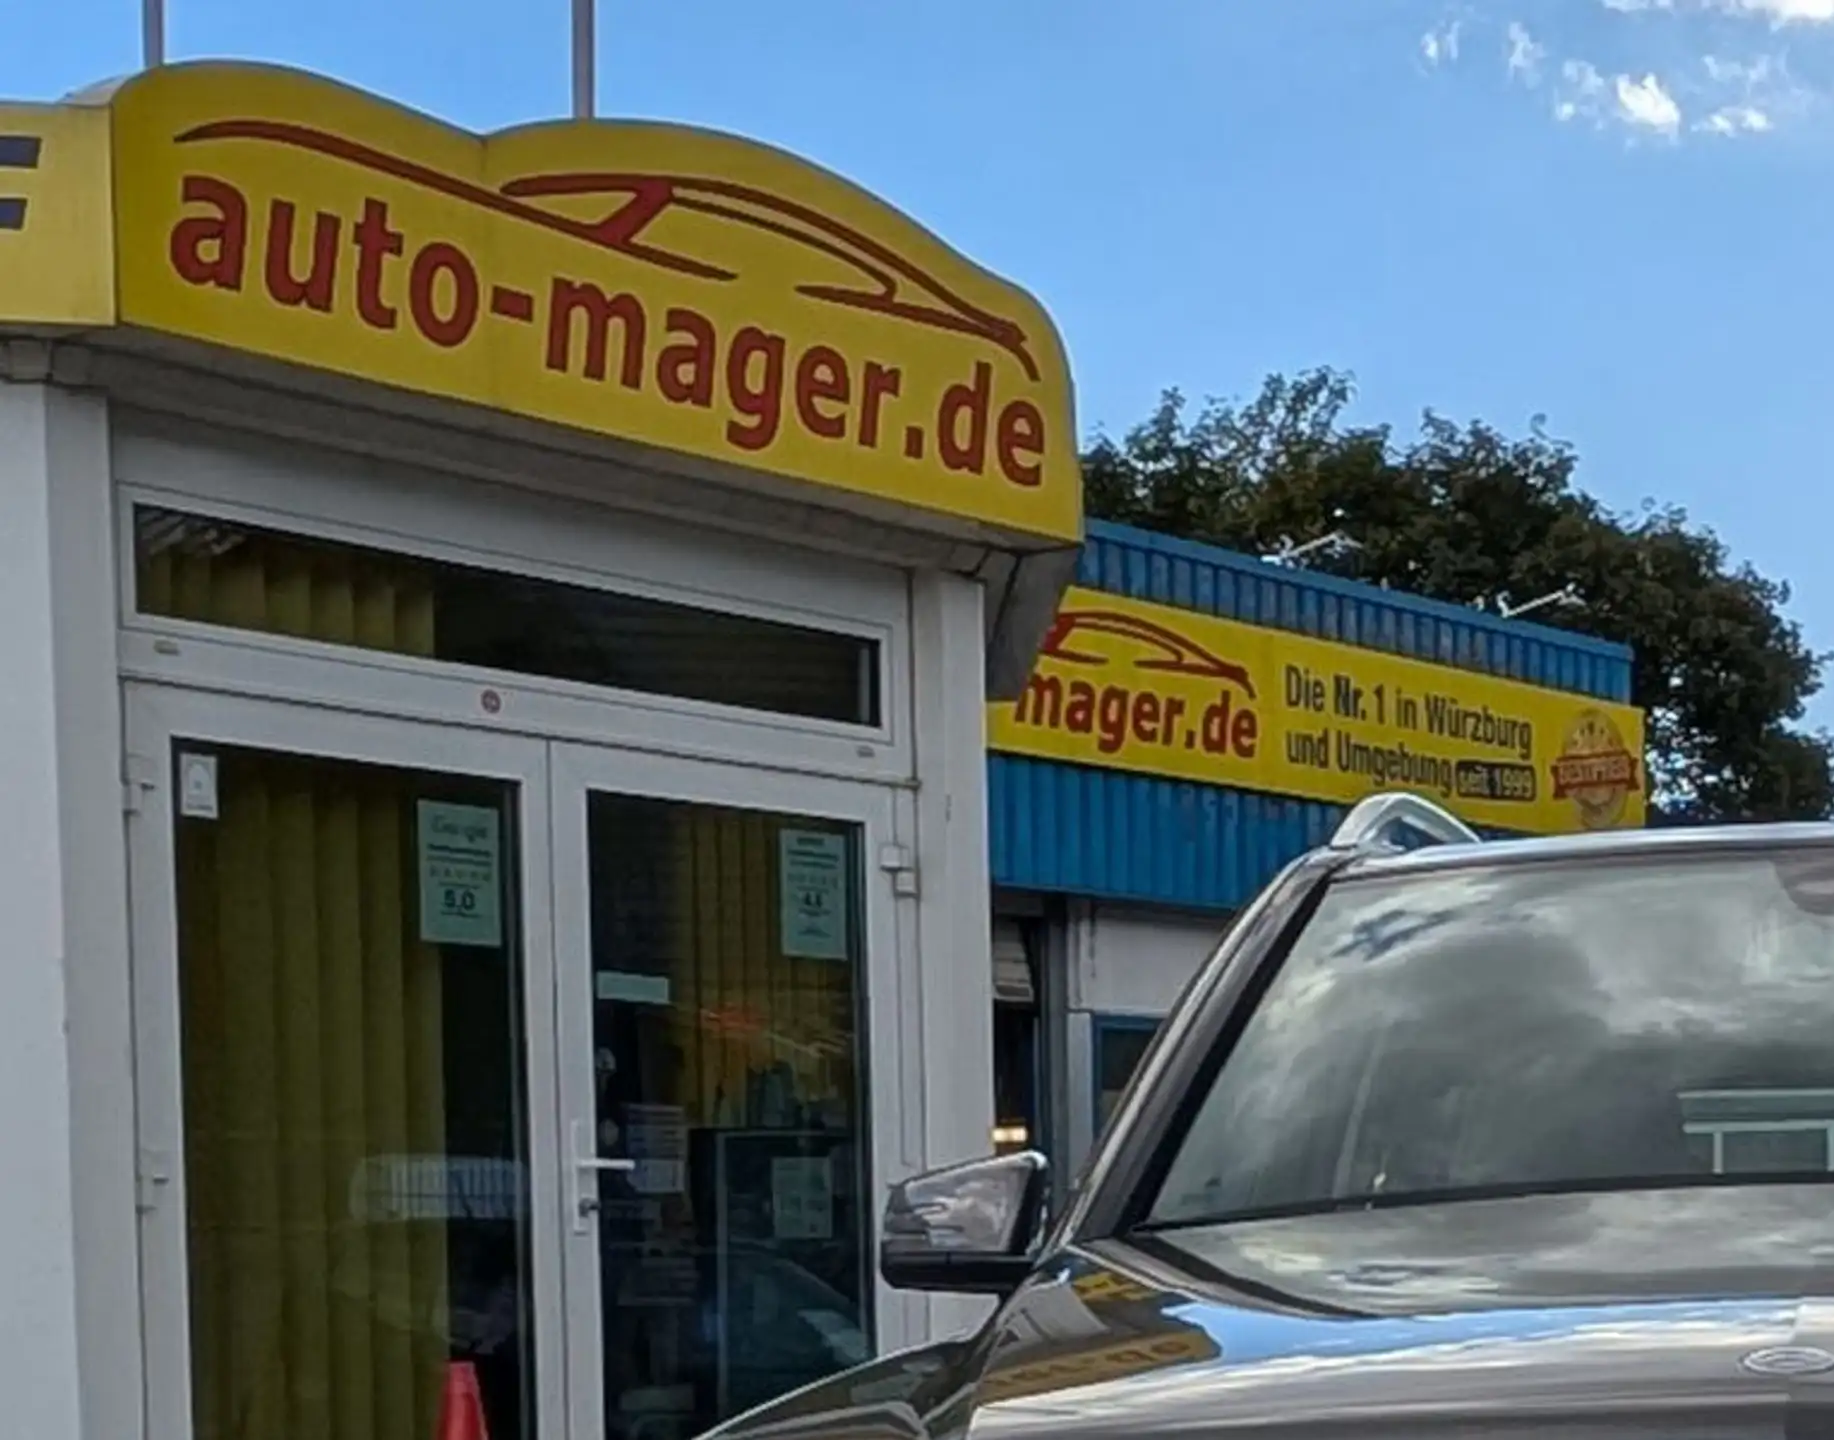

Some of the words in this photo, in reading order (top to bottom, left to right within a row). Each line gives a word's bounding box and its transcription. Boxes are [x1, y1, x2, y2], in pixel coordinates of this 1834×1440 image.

[168, 175, 1047, 488] auto-mager.de
[1284, 664, 1326, 712] Die
[1333, 673, 1368, 721] Nr.
[1373, 683, 1386, 725] 1
[1396, 687, 1417, 732] in
[1425, 692, 1532, 761] Würzburg
[1286, 729, 1329, 770] und
[1336, 729, 1452, 798] Umgebung
